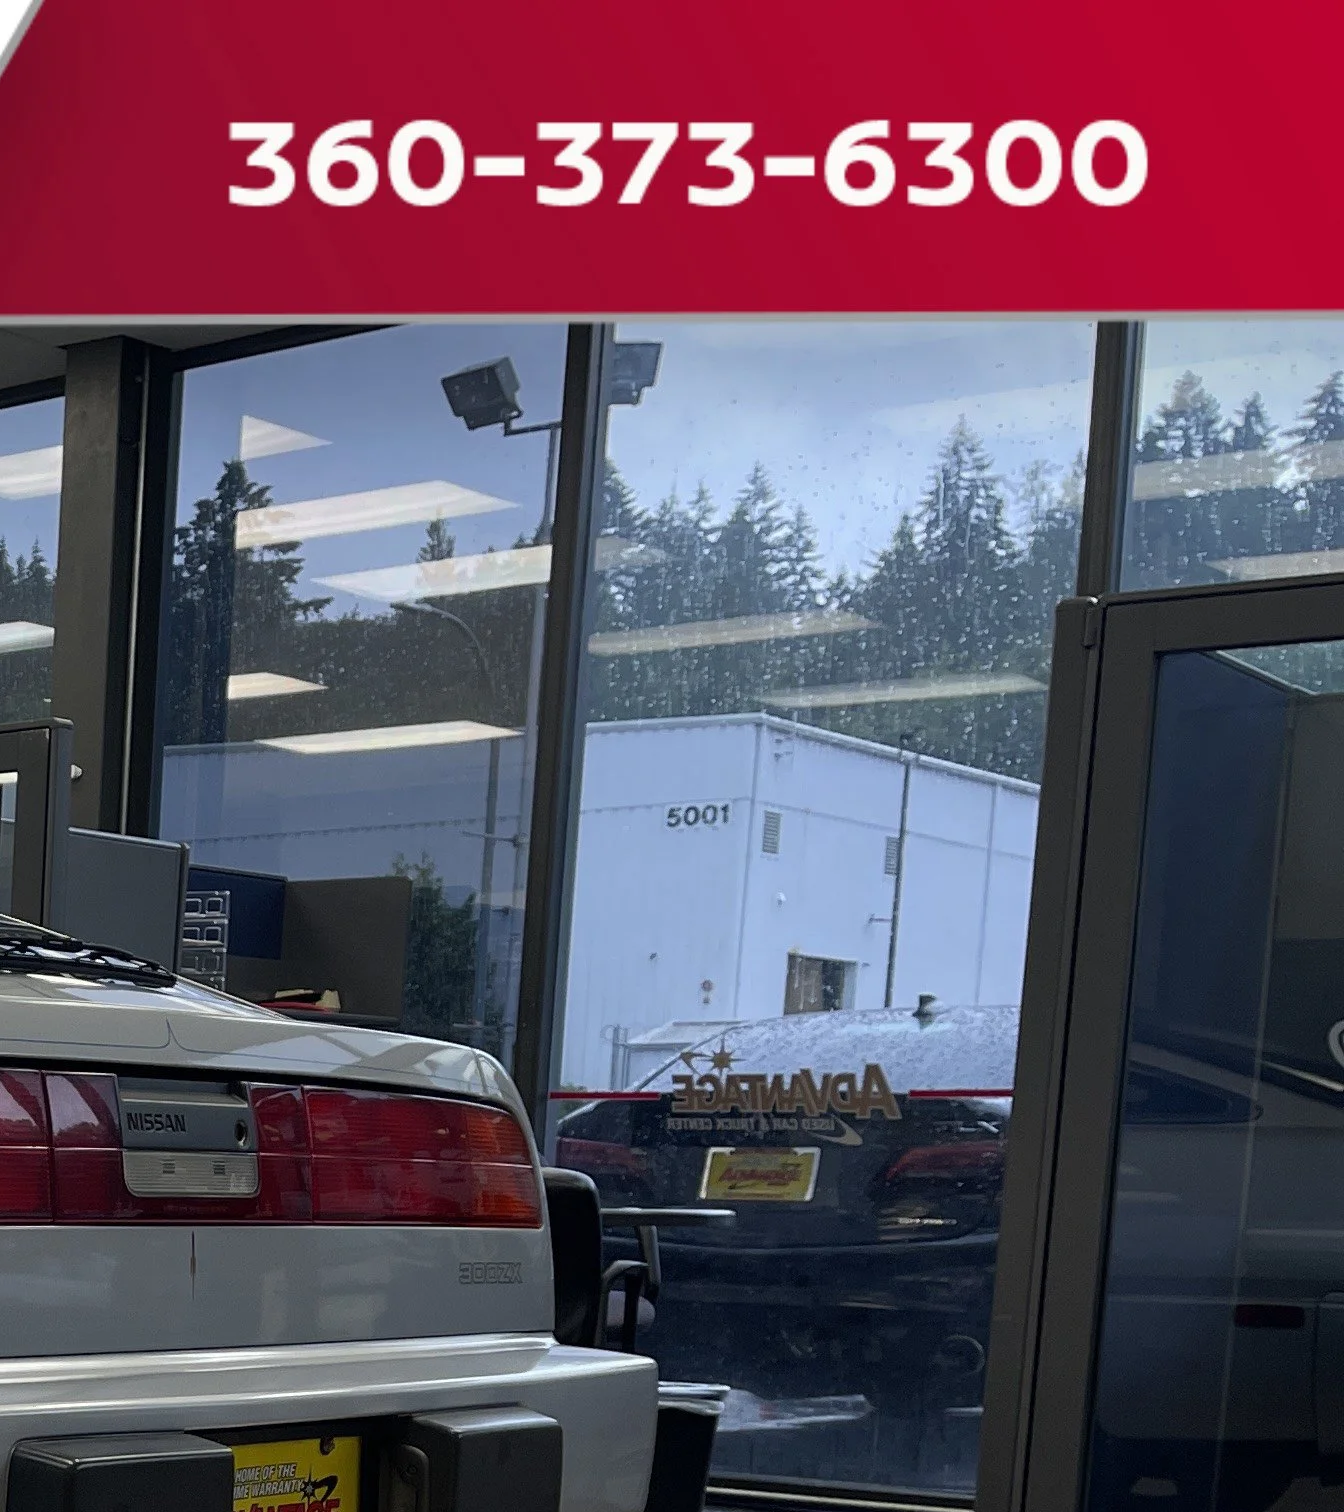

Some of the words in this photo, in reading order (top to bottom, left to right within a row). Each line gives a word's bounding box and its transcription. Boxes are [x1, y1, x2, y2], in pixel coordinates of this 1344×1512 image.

[667, 803, 729, 827] 5001
[126, 1112, 187, 1132] NISSAN
[459, 1262, 523, 1284] 300ZX
[235, 1465, 261, 1482] HOME
[262, 1464, 276, 1480] OF
[277, 1462, 297, 1478] THE
[251, 1479, 303, 1498] WARRANTY
